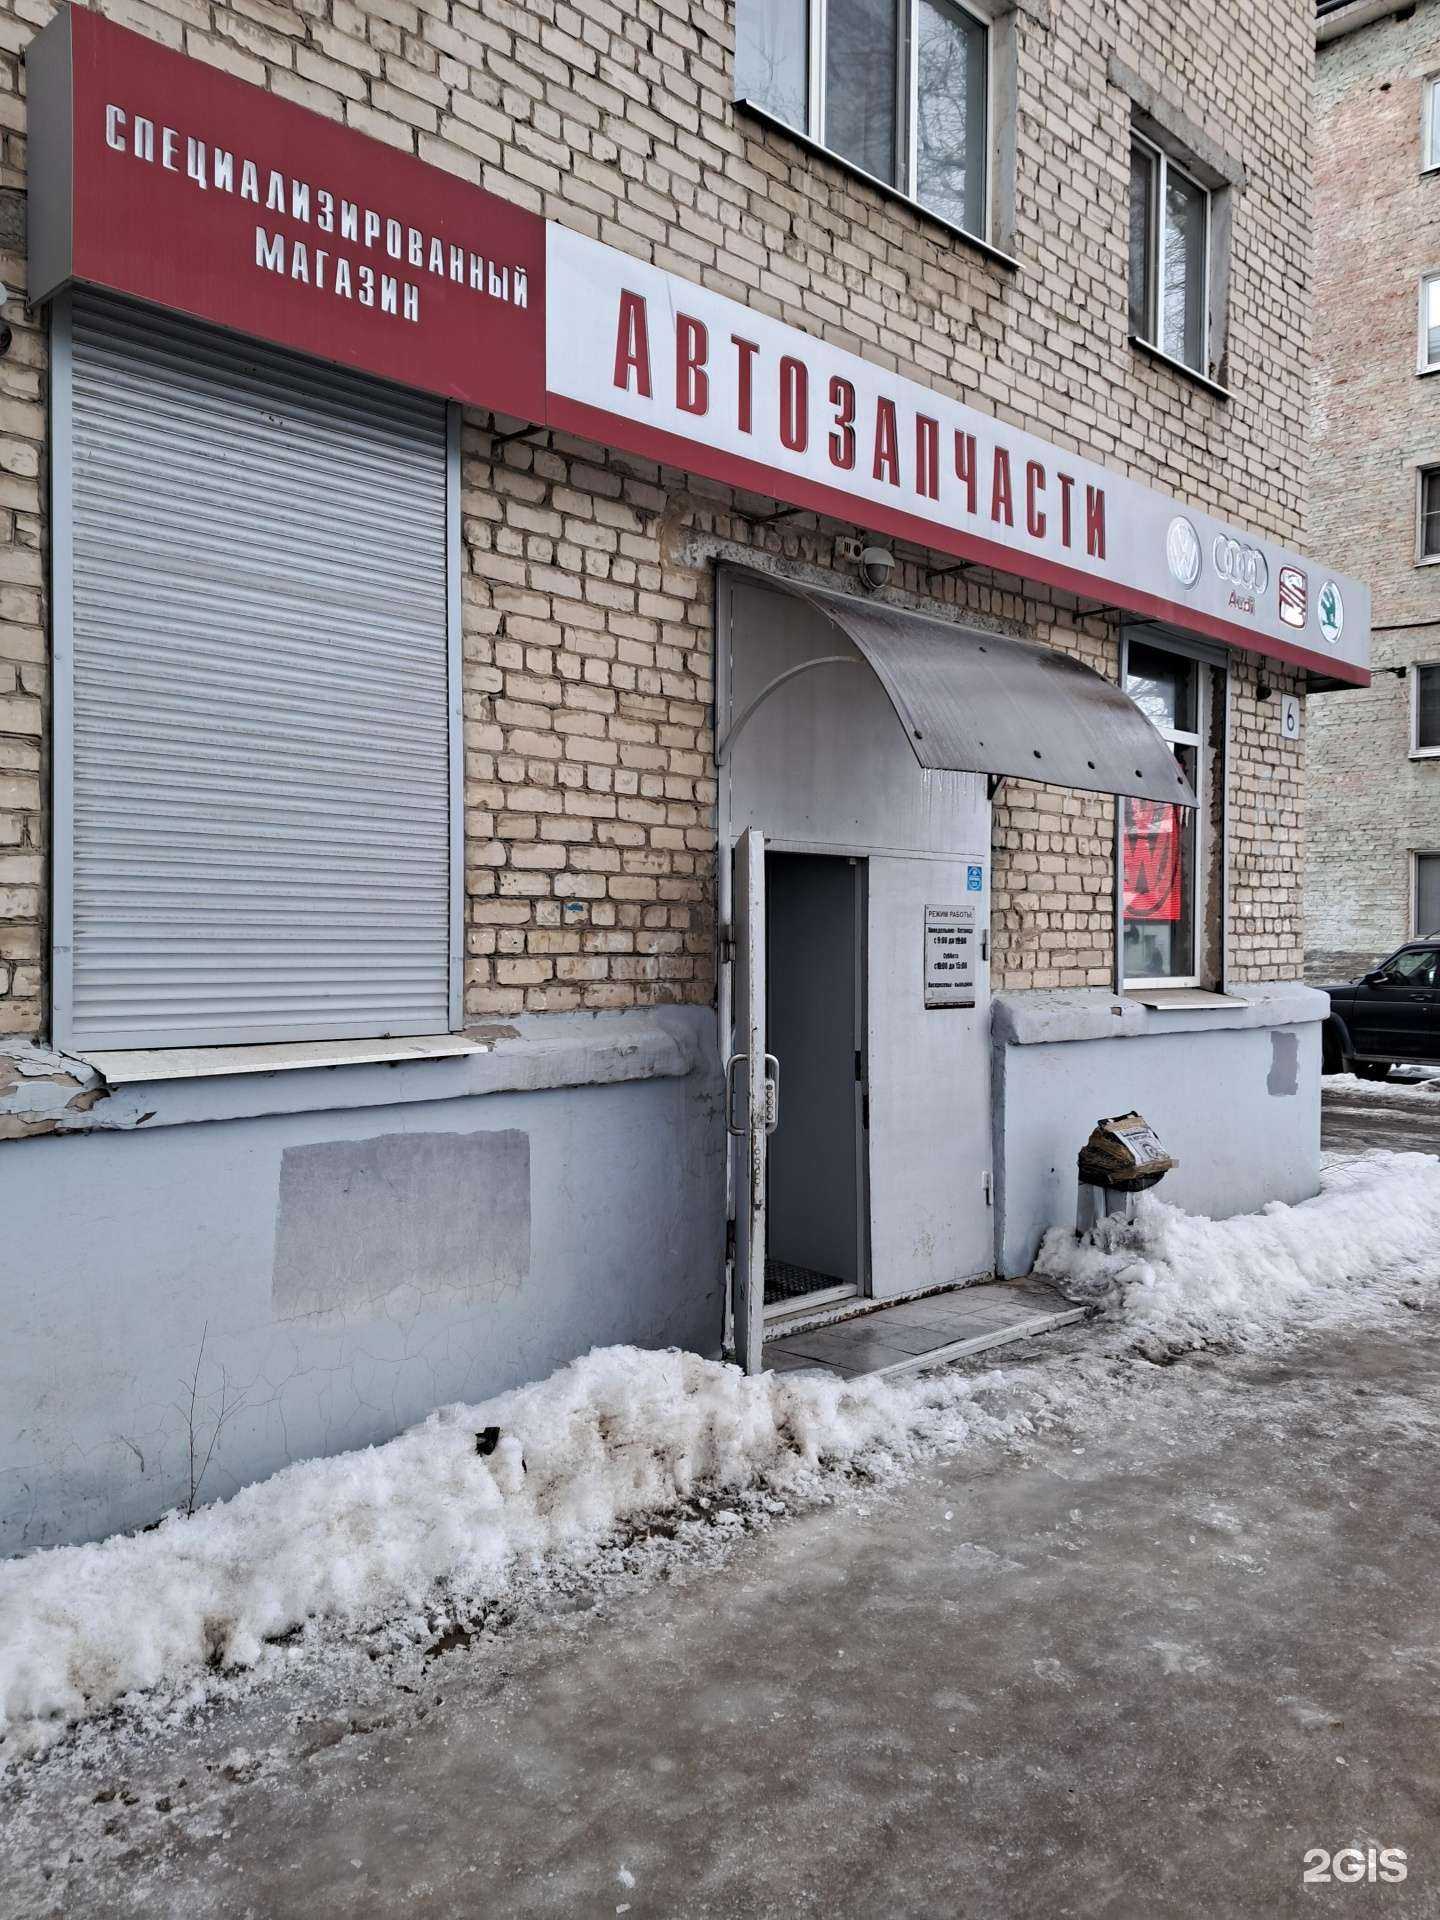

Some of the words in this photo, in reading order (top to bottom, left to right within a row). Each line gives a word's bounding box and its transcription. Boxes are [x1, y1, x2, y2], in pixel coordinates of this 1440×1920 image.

[105, 103, 529, 309] СПЕЦИАЛИЗИРОВАННЫЙ
[255, 226, 420, 322] МАГАЗИН
[612, 287, 1107, 561] АВТОЗАПЧАСТИ
[1228, 589, 1256, 615] Audi
[1286, 702, 1295, 732] 6
[928, 910, 949, 918] РЕЖИМ
